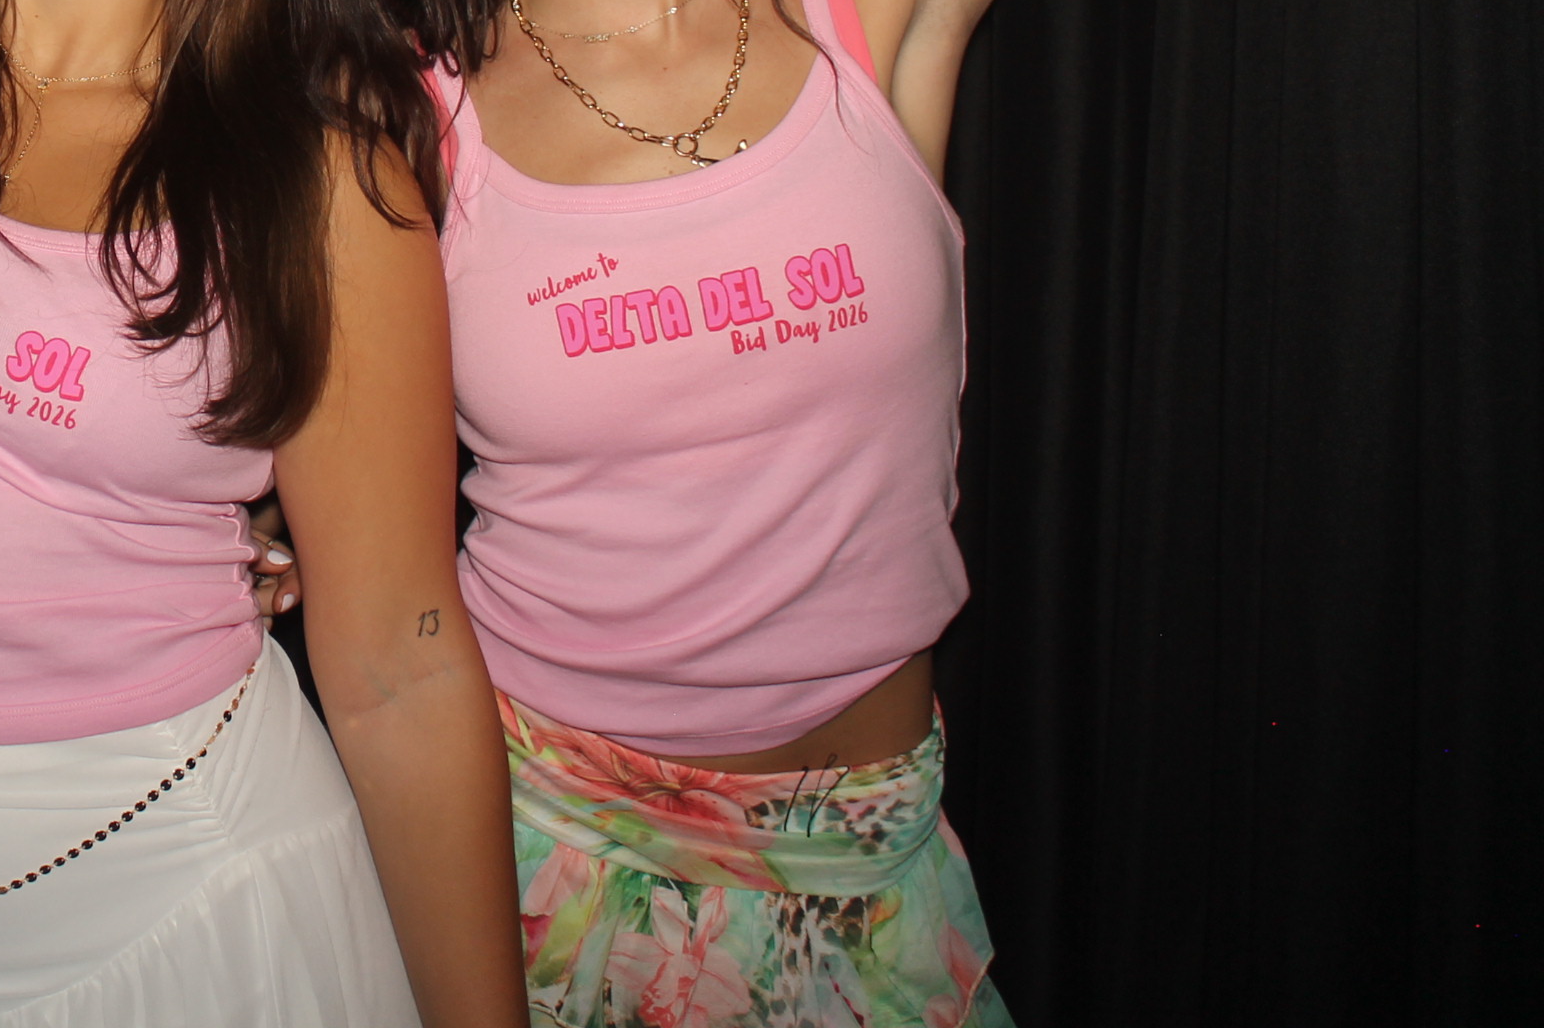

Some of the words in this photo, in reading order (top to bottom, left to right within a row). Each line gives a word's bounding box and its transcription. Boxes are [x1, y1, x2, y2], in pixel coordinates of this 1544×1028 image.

[527, 266, 597, 306] welcome
[596, 252, 619, 279] to
[555, 285, 693, 358] DELTA
[698, 267, 774, 332] DEL
[785, 243, 865, 311] SOL
[730, 325, 767, 355] Bid
[776, 318, 821, 344] Day
[828, 300, 869, 333] 2026
[6, 330, 91, 402] SOL
[26, 396, 77, 430] 2026
[417, 609, 440, 638] 13
